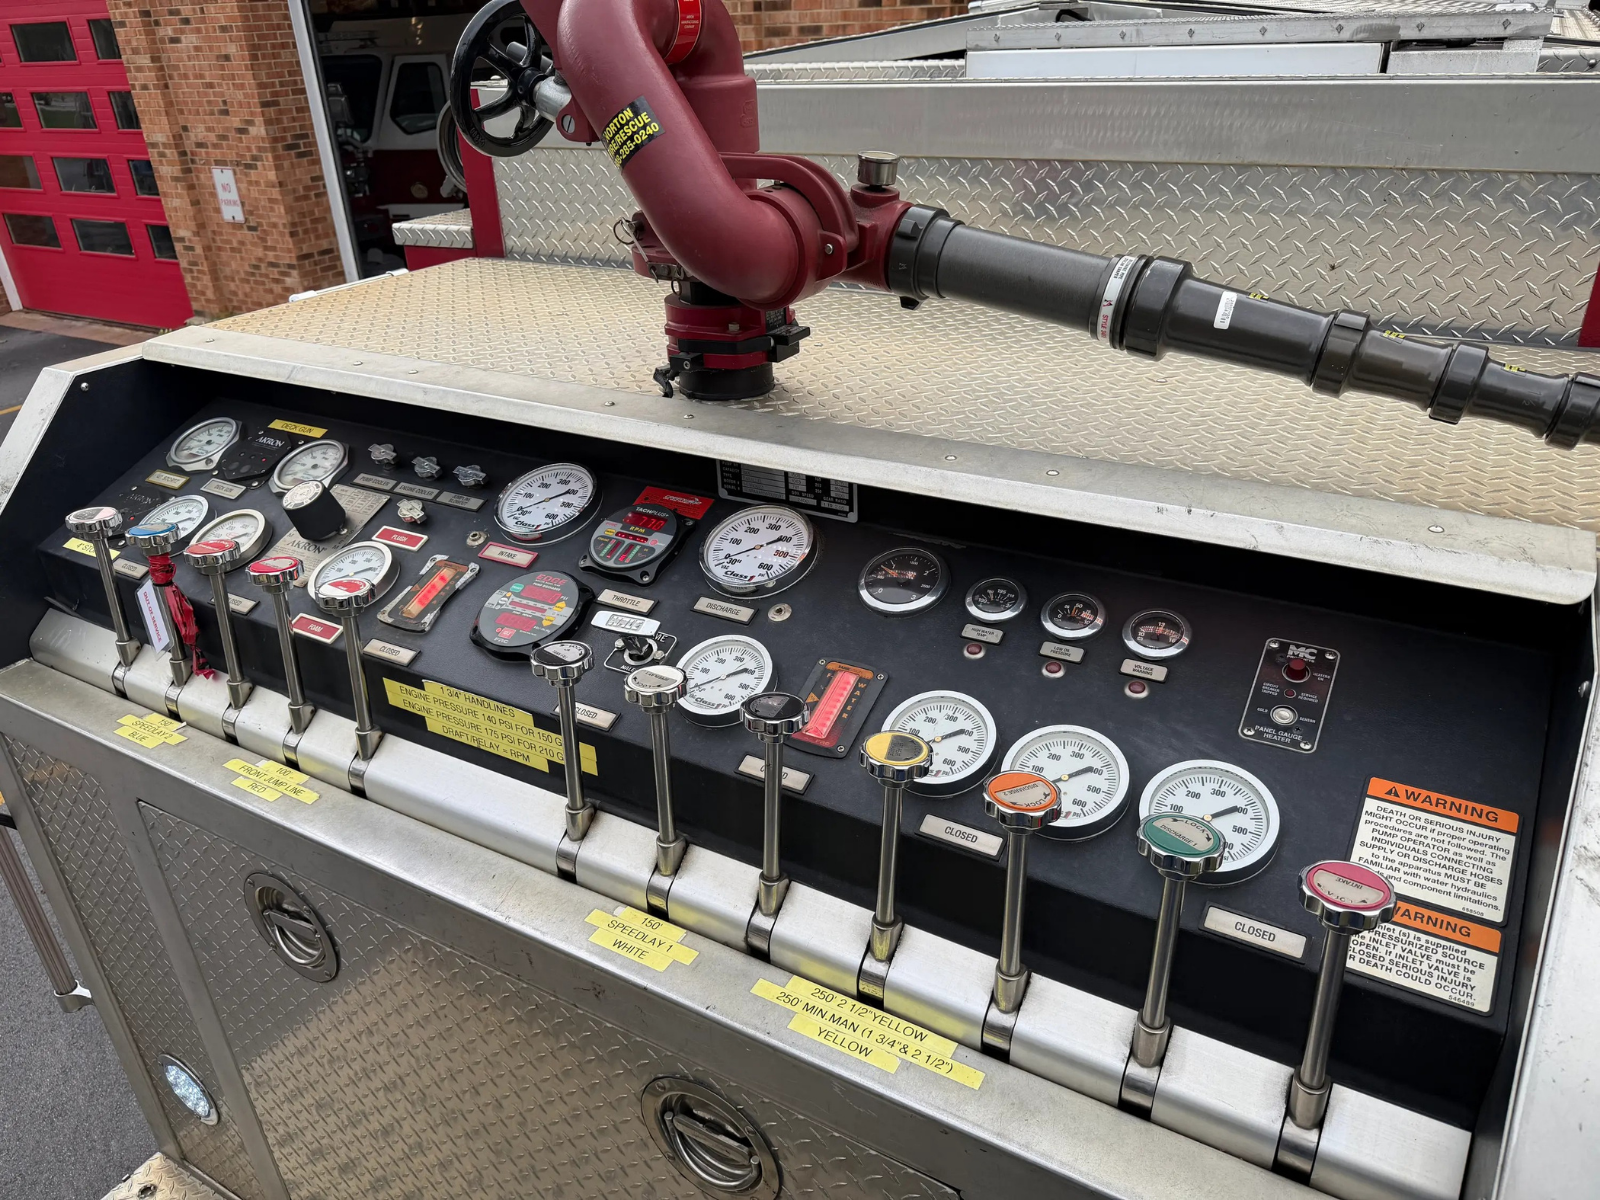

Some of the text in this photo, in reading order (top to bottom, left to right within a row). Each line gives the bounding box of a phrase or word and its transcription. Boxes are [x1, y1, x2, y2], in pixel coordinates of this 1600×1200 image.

[221, 183, 231, 193] NO
[281, 423, 314, 435] DECK GUN
[256, 436, 284, 447] AKRON
[371, 479, 389, 487] COOLER
[415, 488, 434, 496] COOLER
[639, 516, 665, 531] 770
[765, 523, 781, 531] 300
[287, 540, 326, 555] AKRON
[729, 537, 742, 545] 100
[498, 550, 518, 560] INTAKE
[773, 550, 789, 558] 500
[536, 574, 568, 586] EDGE
[612, 595, 641, 606] THROTTLE
[706, 603, 741, 615] DISCHARGE
[152, 616, 161, 642] SERVICE
[308, 623, 323, 633] FOAM
[379, 645, 400, 657] CLOSED
[1287, 644, 1318, 660] MC
[1135, 664, 1154, 672] VOLTAGE
[440, 686, 516, 719] 1 3/4" HANDLINES
[842, 683, 867, 719] WATER
[399, 685, 431, 701] ENGINE
[433, 695, 480, 720] PRESSURE
[482, 712, 497, 725] 140
[498, 716, 514, 730] PSI
[515, 722, 535, 737] FOR
[537, 730, 554, 742] 150
[128, 731, 150, 741] BLUE
[132, 720, 168, 737] SPEEDLAY
[403, 699, 434, 715] ENGINE
[436, 709, 483, 734] PRESSURE
[484, 726, 500, 740] 175
[500, 732, 517, 745] PSI
[517, 738, 537, 752] FOR
[539, 744, 555, 756] 210
[1255, 725, 1303, 741] PANEL GAUGE
[442, 725, 531, 763] DRAFT/RELAY RPM
[1263, 733, 1291, 744] HEATER
[239, 765, 305, 796] FRONT JUMP LINE
[248, 782, 267, 793] RED
[1185, 790, 1201, 800] 200
[1210, 788, 1227, 799] 300
[1169, 803, 1184, 814] 100
[1404, 788, 1499, 823] WARNING
[1160, 824, 1193, 844] DISCHARGE
[1185, 819, 1207, 834] LOCK
[1231, 824, 1248, 836] 500
[1364, 811, 1394, 824] MIGHT
[1395, 818, 1428, 832] OCCUR
[1437, 829, 1467, 842] proper
[1468, 838, 1510, 855] operating
[1376, 805, 1501, 843] DEATH OR SERIOUS INJURY
[944, 825, 978, 845] CLOSED
[1364, 819, 1507, 862] procedures are not followed. The
[1371, 836, 1494, 875] INDIVIDUALS CONNECTING
[1372, 828, 1398, 839] PUMP
[1400, 835, 1450, 854] OPERATOR
[1465, 853, 1484, 863] well
[1359, 840, 1503, 886] SUPPLY OR DISCHARGE HOSES
[1382, 855, 1395, 863] the
[1398, 860, 1442, 878] apparatus
[1444, 872, 1472, 886] MUST
[1473, 881, 1487, 889] BE
[1358, 856, 1498, 902] FAMILIAR with water hydraulics
[1386, 874, 1501, 912] and component limitations.
[641, 916, 664, 930] 150'
[1234, 920, 1276, 942] CLOSED
[607, 919, 674, 952] SPEEDLAY 1
[1398, 929, 1410, 939] (s)
[1424, 937, 1467, 956] supplied
[612, 938, 649, 960] WHITE
[1368, 929, 1486, 970] PRESSURIZED SOURCE
[1368, 936, 1476, 976] INLET VALVE must be
[1352, 940, 1382, 954] OPEN.
[1394, 952, 1425, 967] INLET
[1427, 963, 1460, 979] VALVE
[1358, 957, 1477, 1001] DEATH COULD OCCUR.
[1388, 957, 1476, 992] SERIOUS INJURY
[810, 987, 838, 1005] 250'
[839, 997, 848, 1008] 2
[775, 990, 803, 1008] 250'
[801, 1001, 860, 1034] MIN.MAN
[860, 1027, 873, 1040] (1
[911, 1049, 921, 1059] 2
[925, 1054, 954, 1074] 1/2")
[816, 1026, 874, 1058] YELLOW
